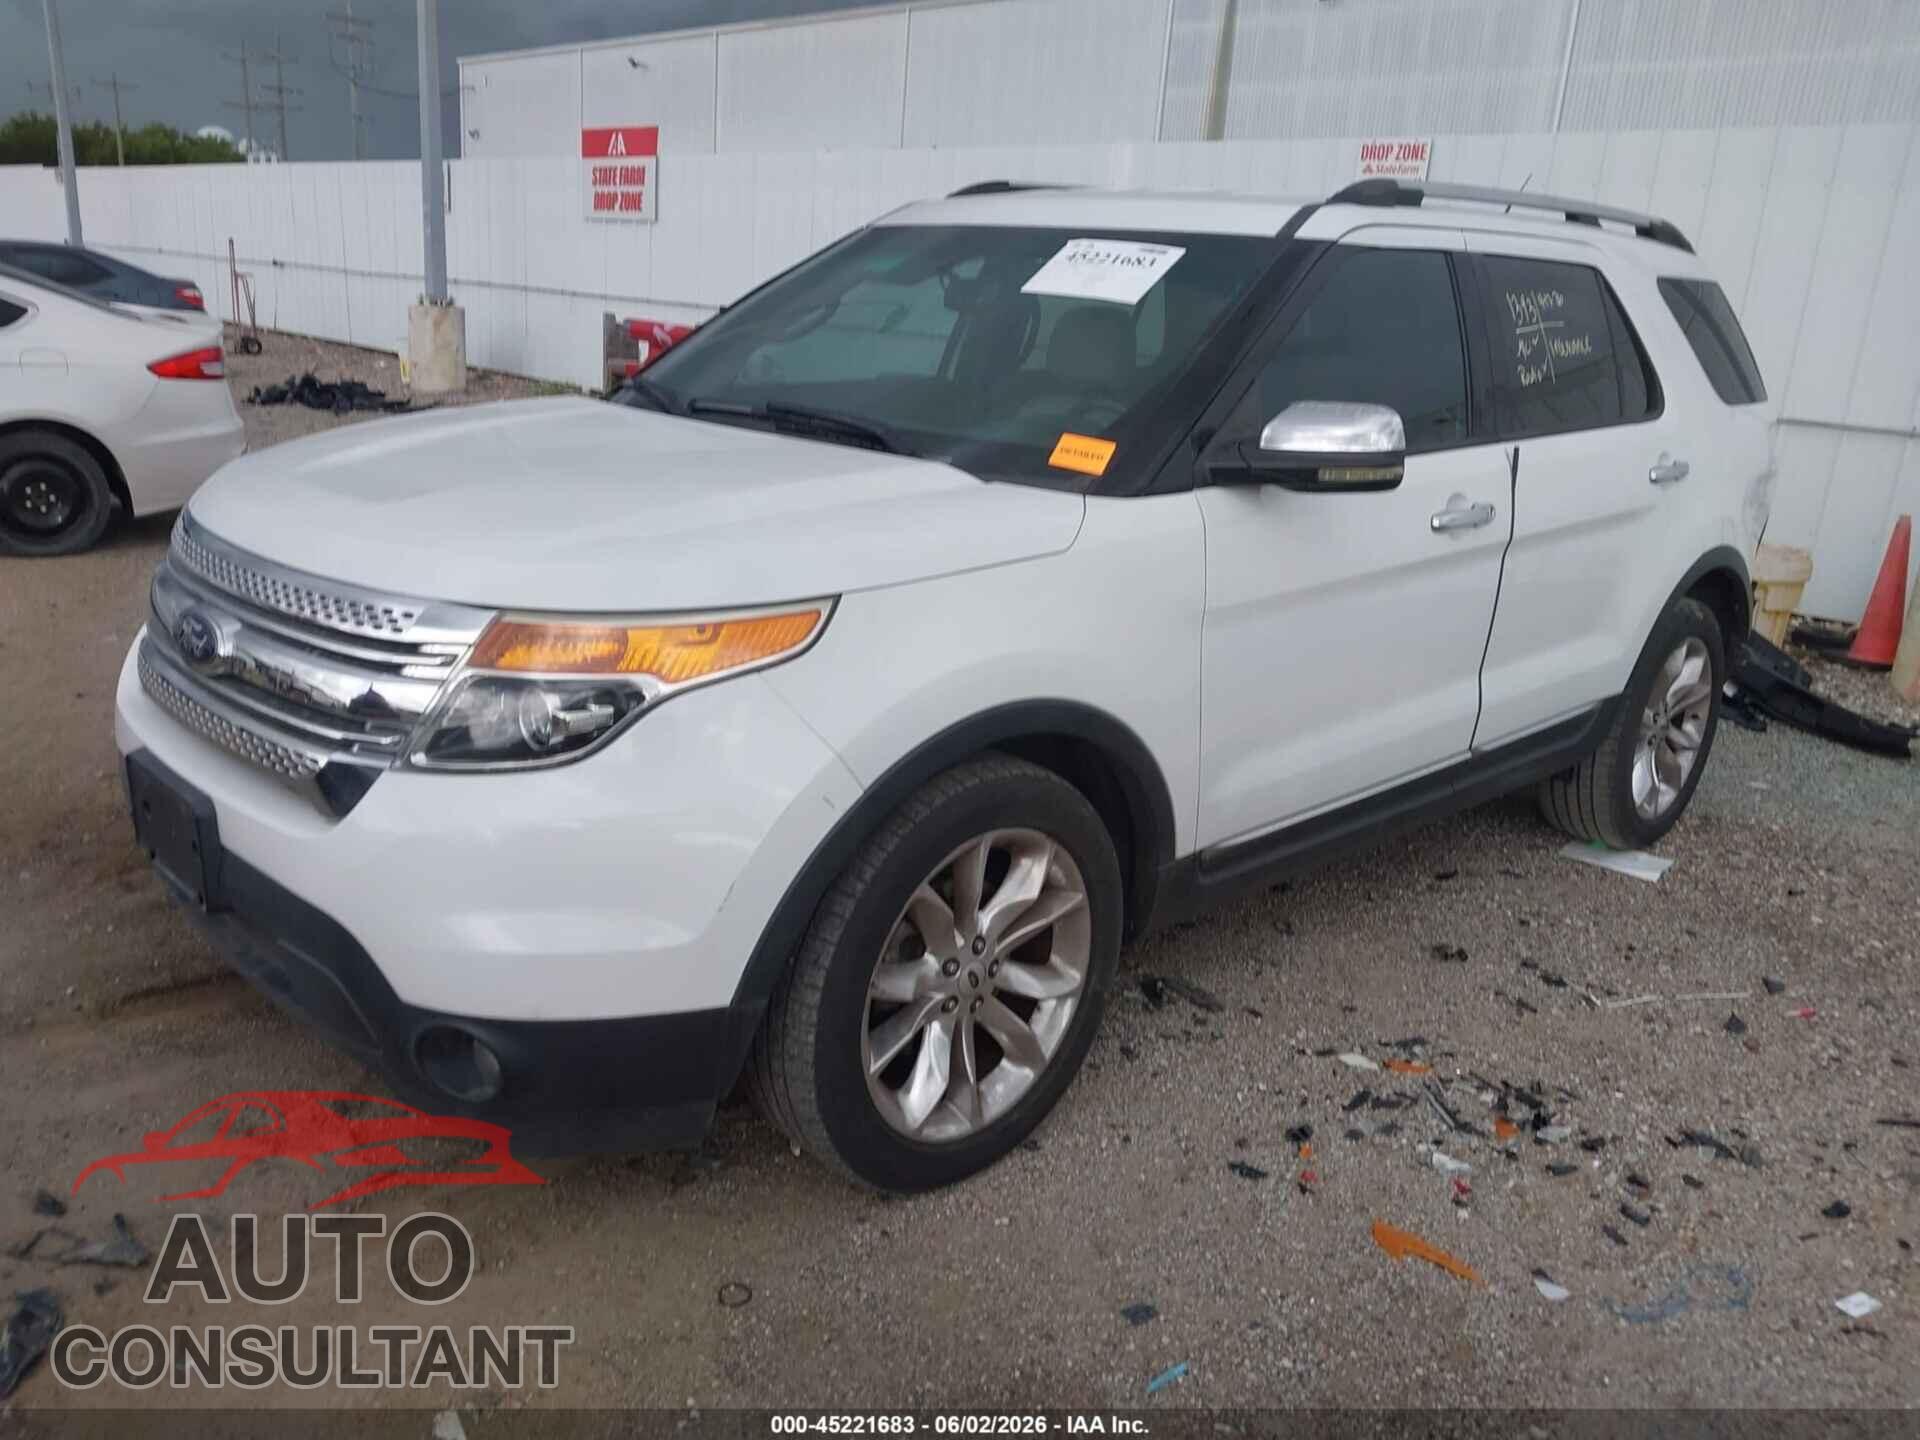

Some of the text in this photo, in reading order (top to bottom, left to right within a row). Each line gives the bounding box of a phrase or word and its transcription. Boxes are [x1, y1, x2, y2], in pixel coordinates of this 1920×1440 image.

[1361, 143, 1425, 161] DROP ZONE
[592, 165, 646, 186] STATE FARM
[593, 191, 642, 211] DROP ZONE
